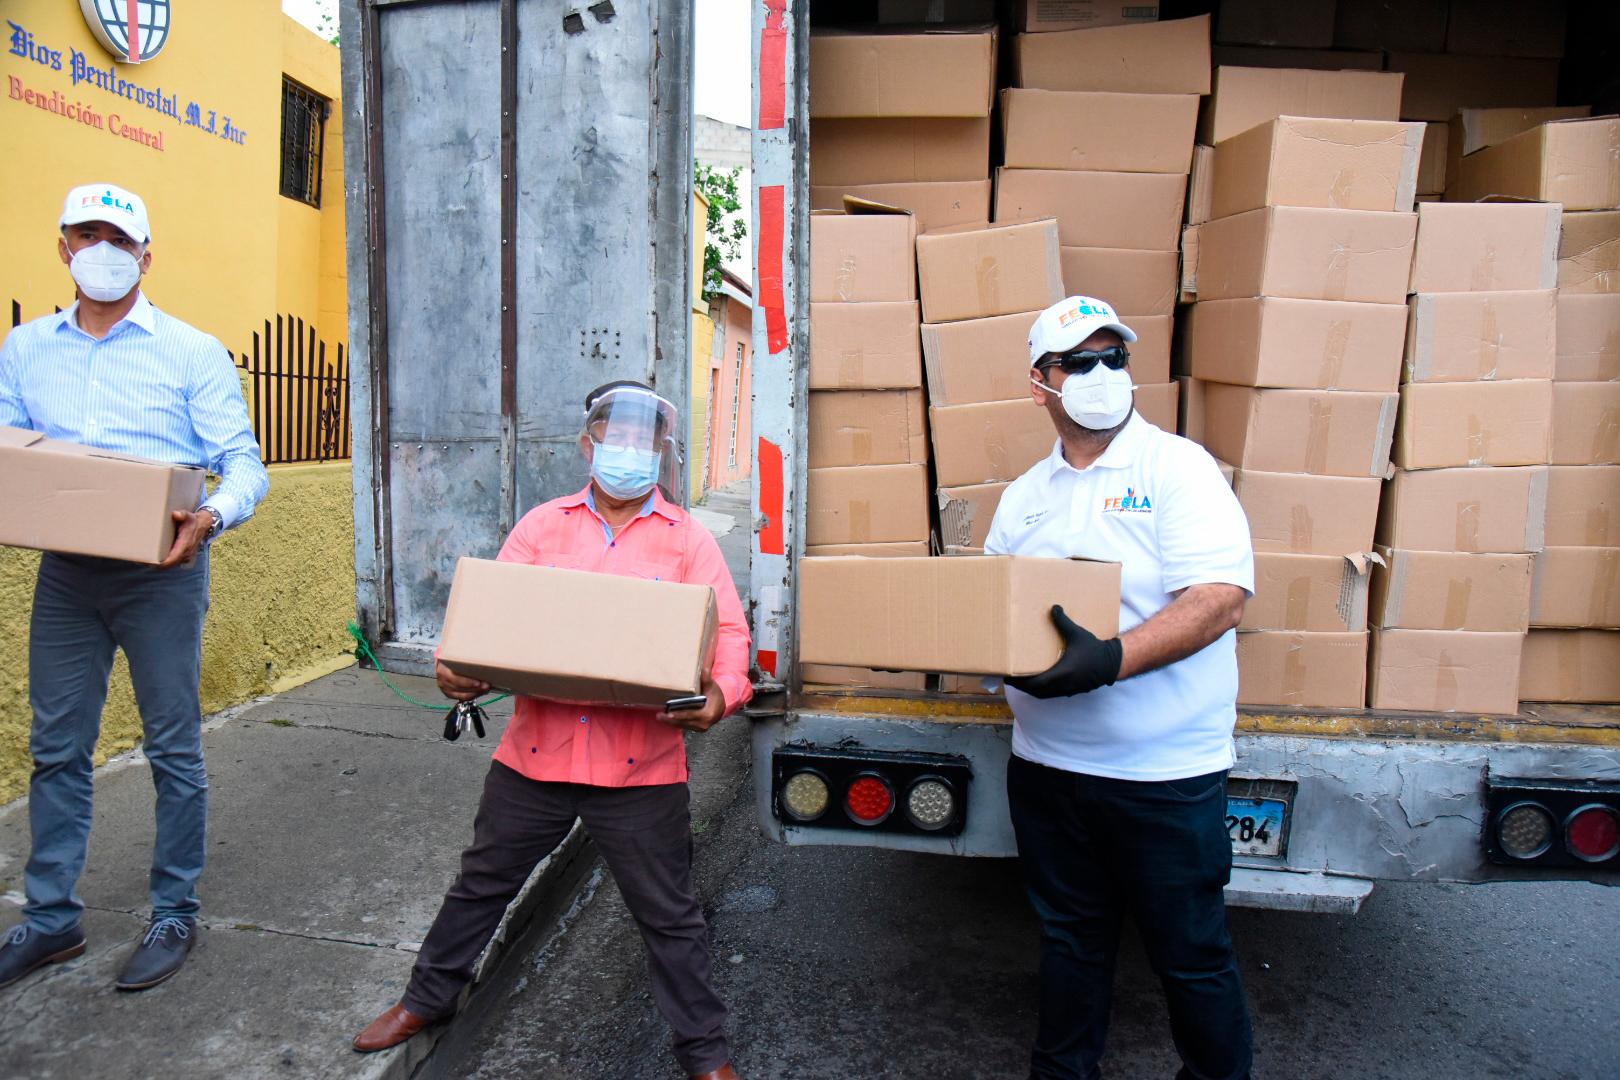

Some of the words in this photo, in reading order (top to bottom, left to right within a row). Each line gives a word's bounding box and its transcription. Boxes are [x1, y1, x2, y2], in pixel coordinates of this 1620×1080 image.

[6, 19, 63, 71] Dios
[69, 46, 183, 125] Pentecostal,
[8, 74, 104, 130] Bendición
[108, 113, 165, 152] Central
